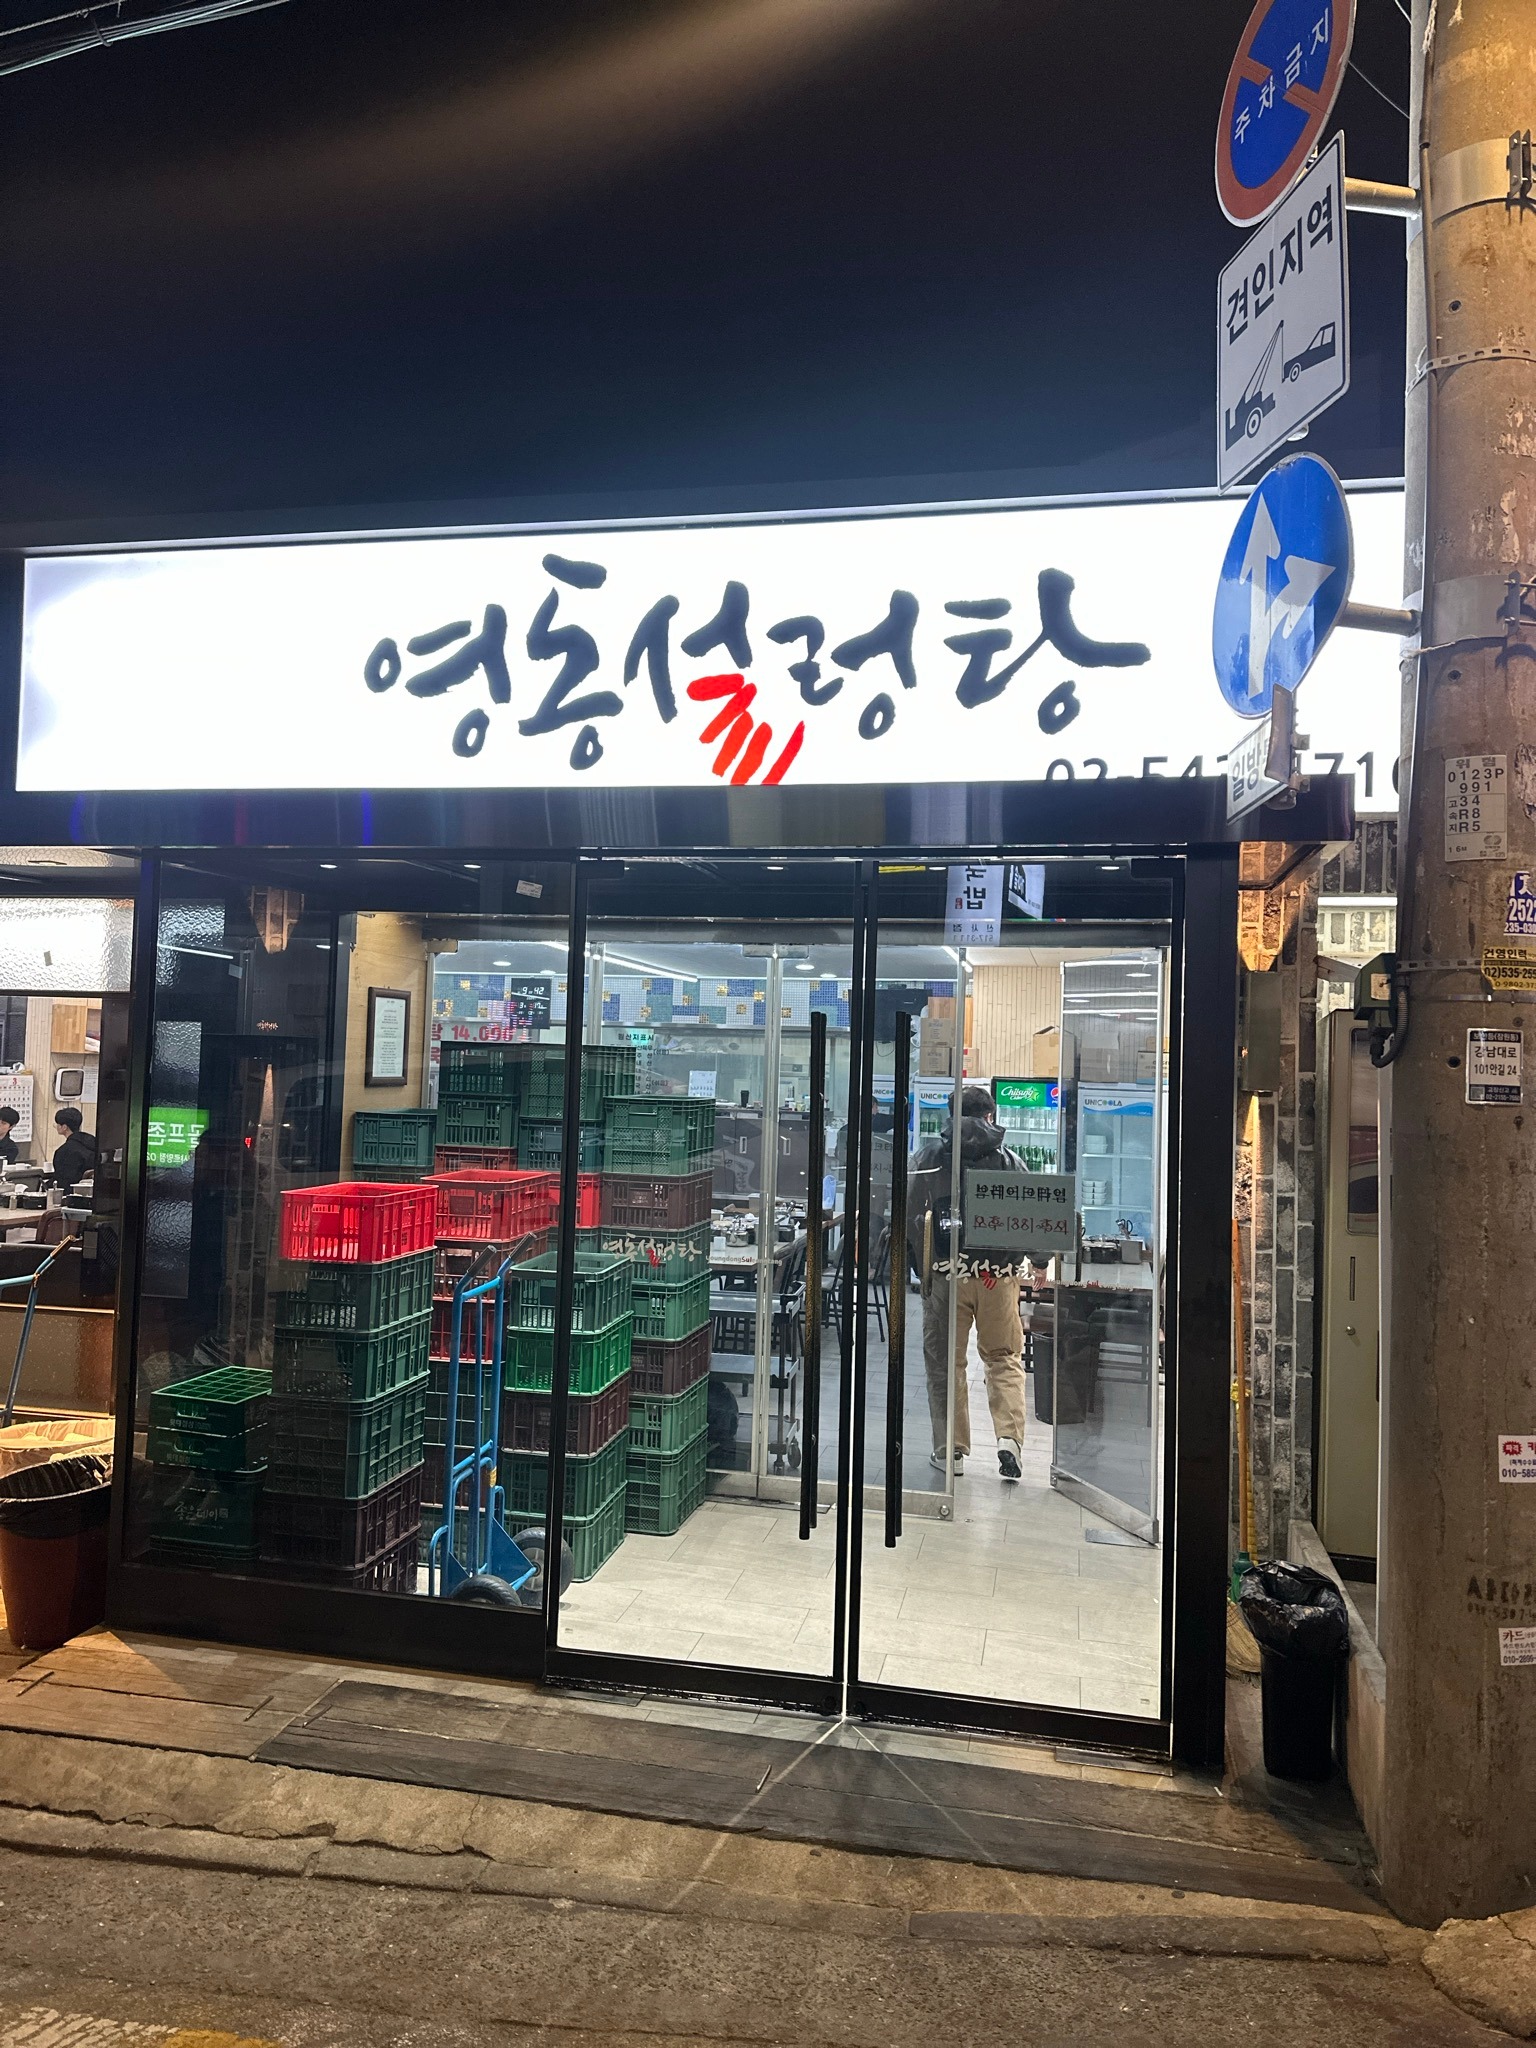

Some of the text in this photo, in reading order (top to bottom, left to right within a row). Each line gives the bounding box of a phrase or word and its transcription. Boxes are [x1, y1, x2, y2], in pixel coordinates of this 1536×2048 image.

[1234, 8, 1329, 145] 주차금지
[1226, 186, 1333, 345] 견인지역
[365, 553, 1151, 785] 영동설렁탕
[1232, 738, 1268, 802] 일방
[1448, 768, 1504, 783] 0123P
[1460, 781, 1491, 793] 991
[1484, 949, 1527, 960] 건영인력
[1475, 1046, 1517, 1058] 강남대로
[1474, 1064, 1517, 1076] 101안길 24
[1502, 1468, 1536, 1478] 010-585
[1503, 1629, 1525, 1643] 카드
